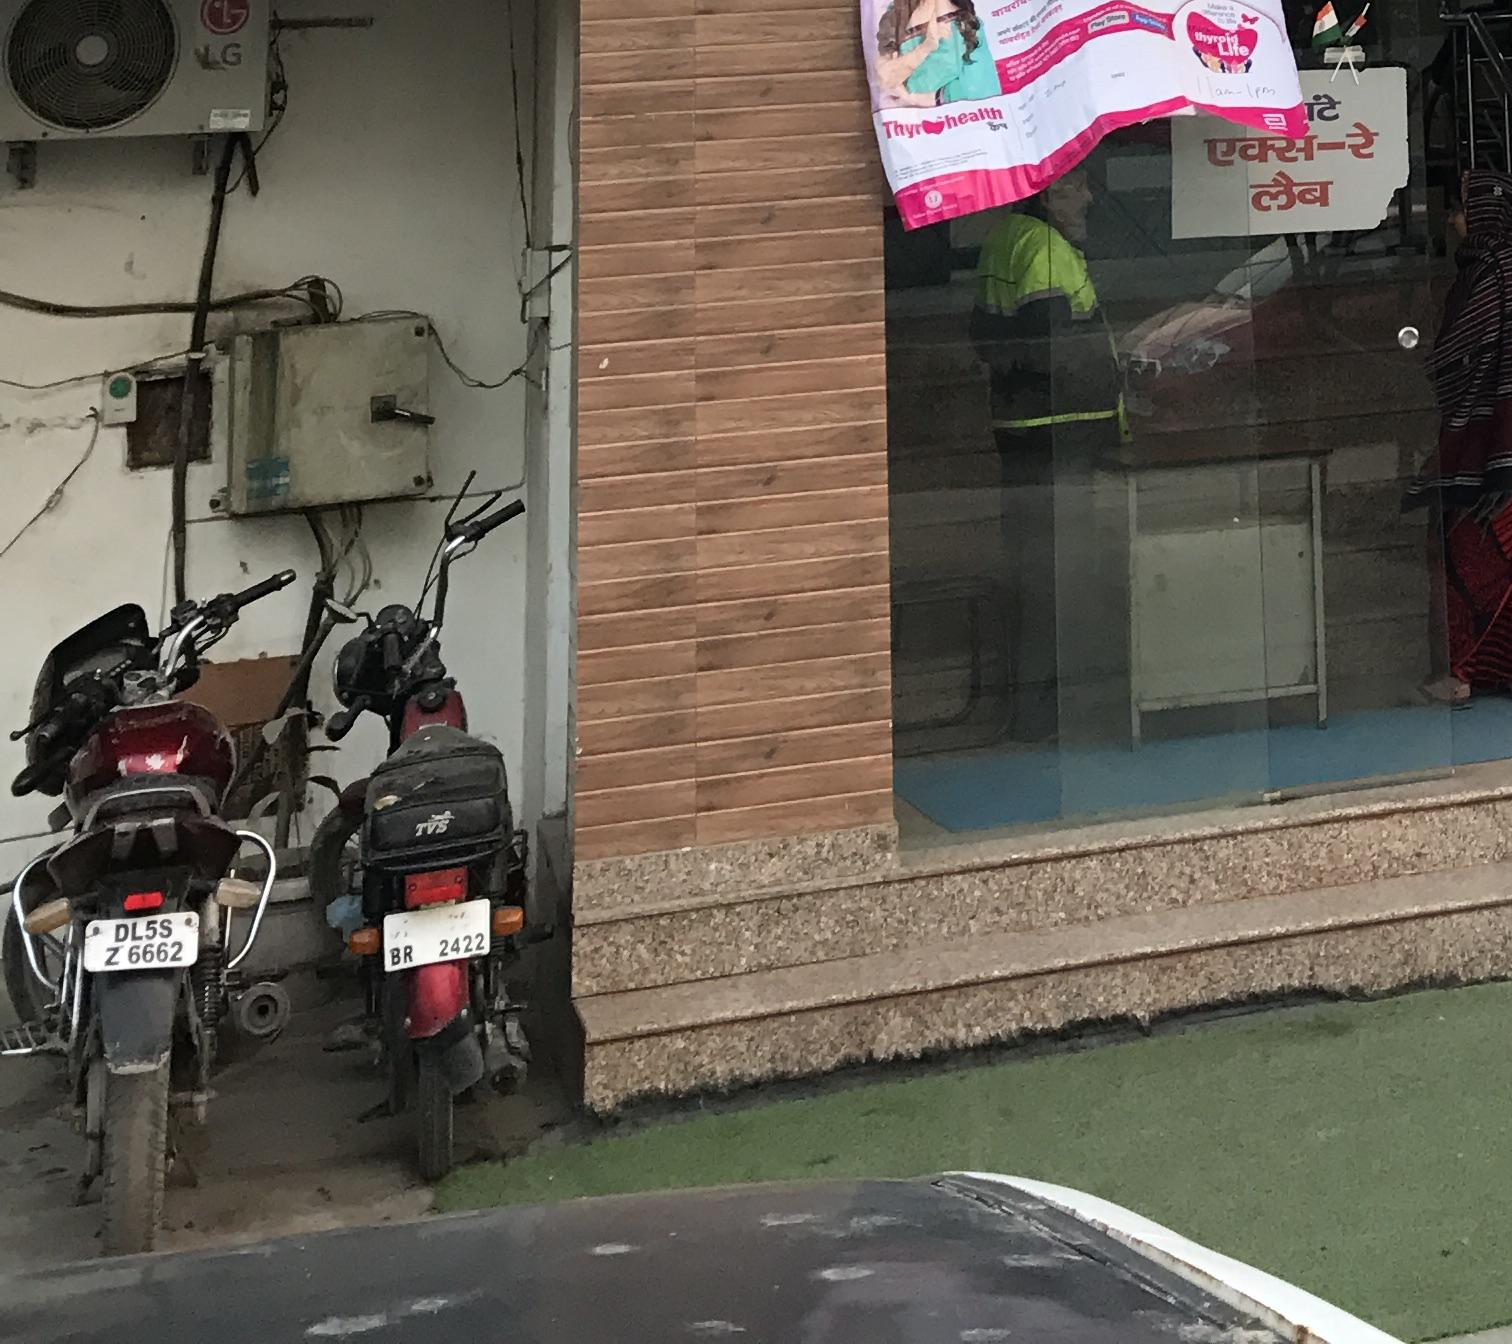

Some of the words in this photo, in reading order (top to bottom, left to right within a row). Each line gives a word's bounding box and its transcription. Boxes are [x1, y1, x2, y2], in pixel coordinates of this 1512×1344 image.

[1249, 170, 1333, 212] लैब
[115, 919, 173, 943] DL5S
[104, 945, 123, 967] Z
[128, 941, 183, 964] 6662
[389, 945, 413, 966] BR
[439, 932, 485, 957] 2422
